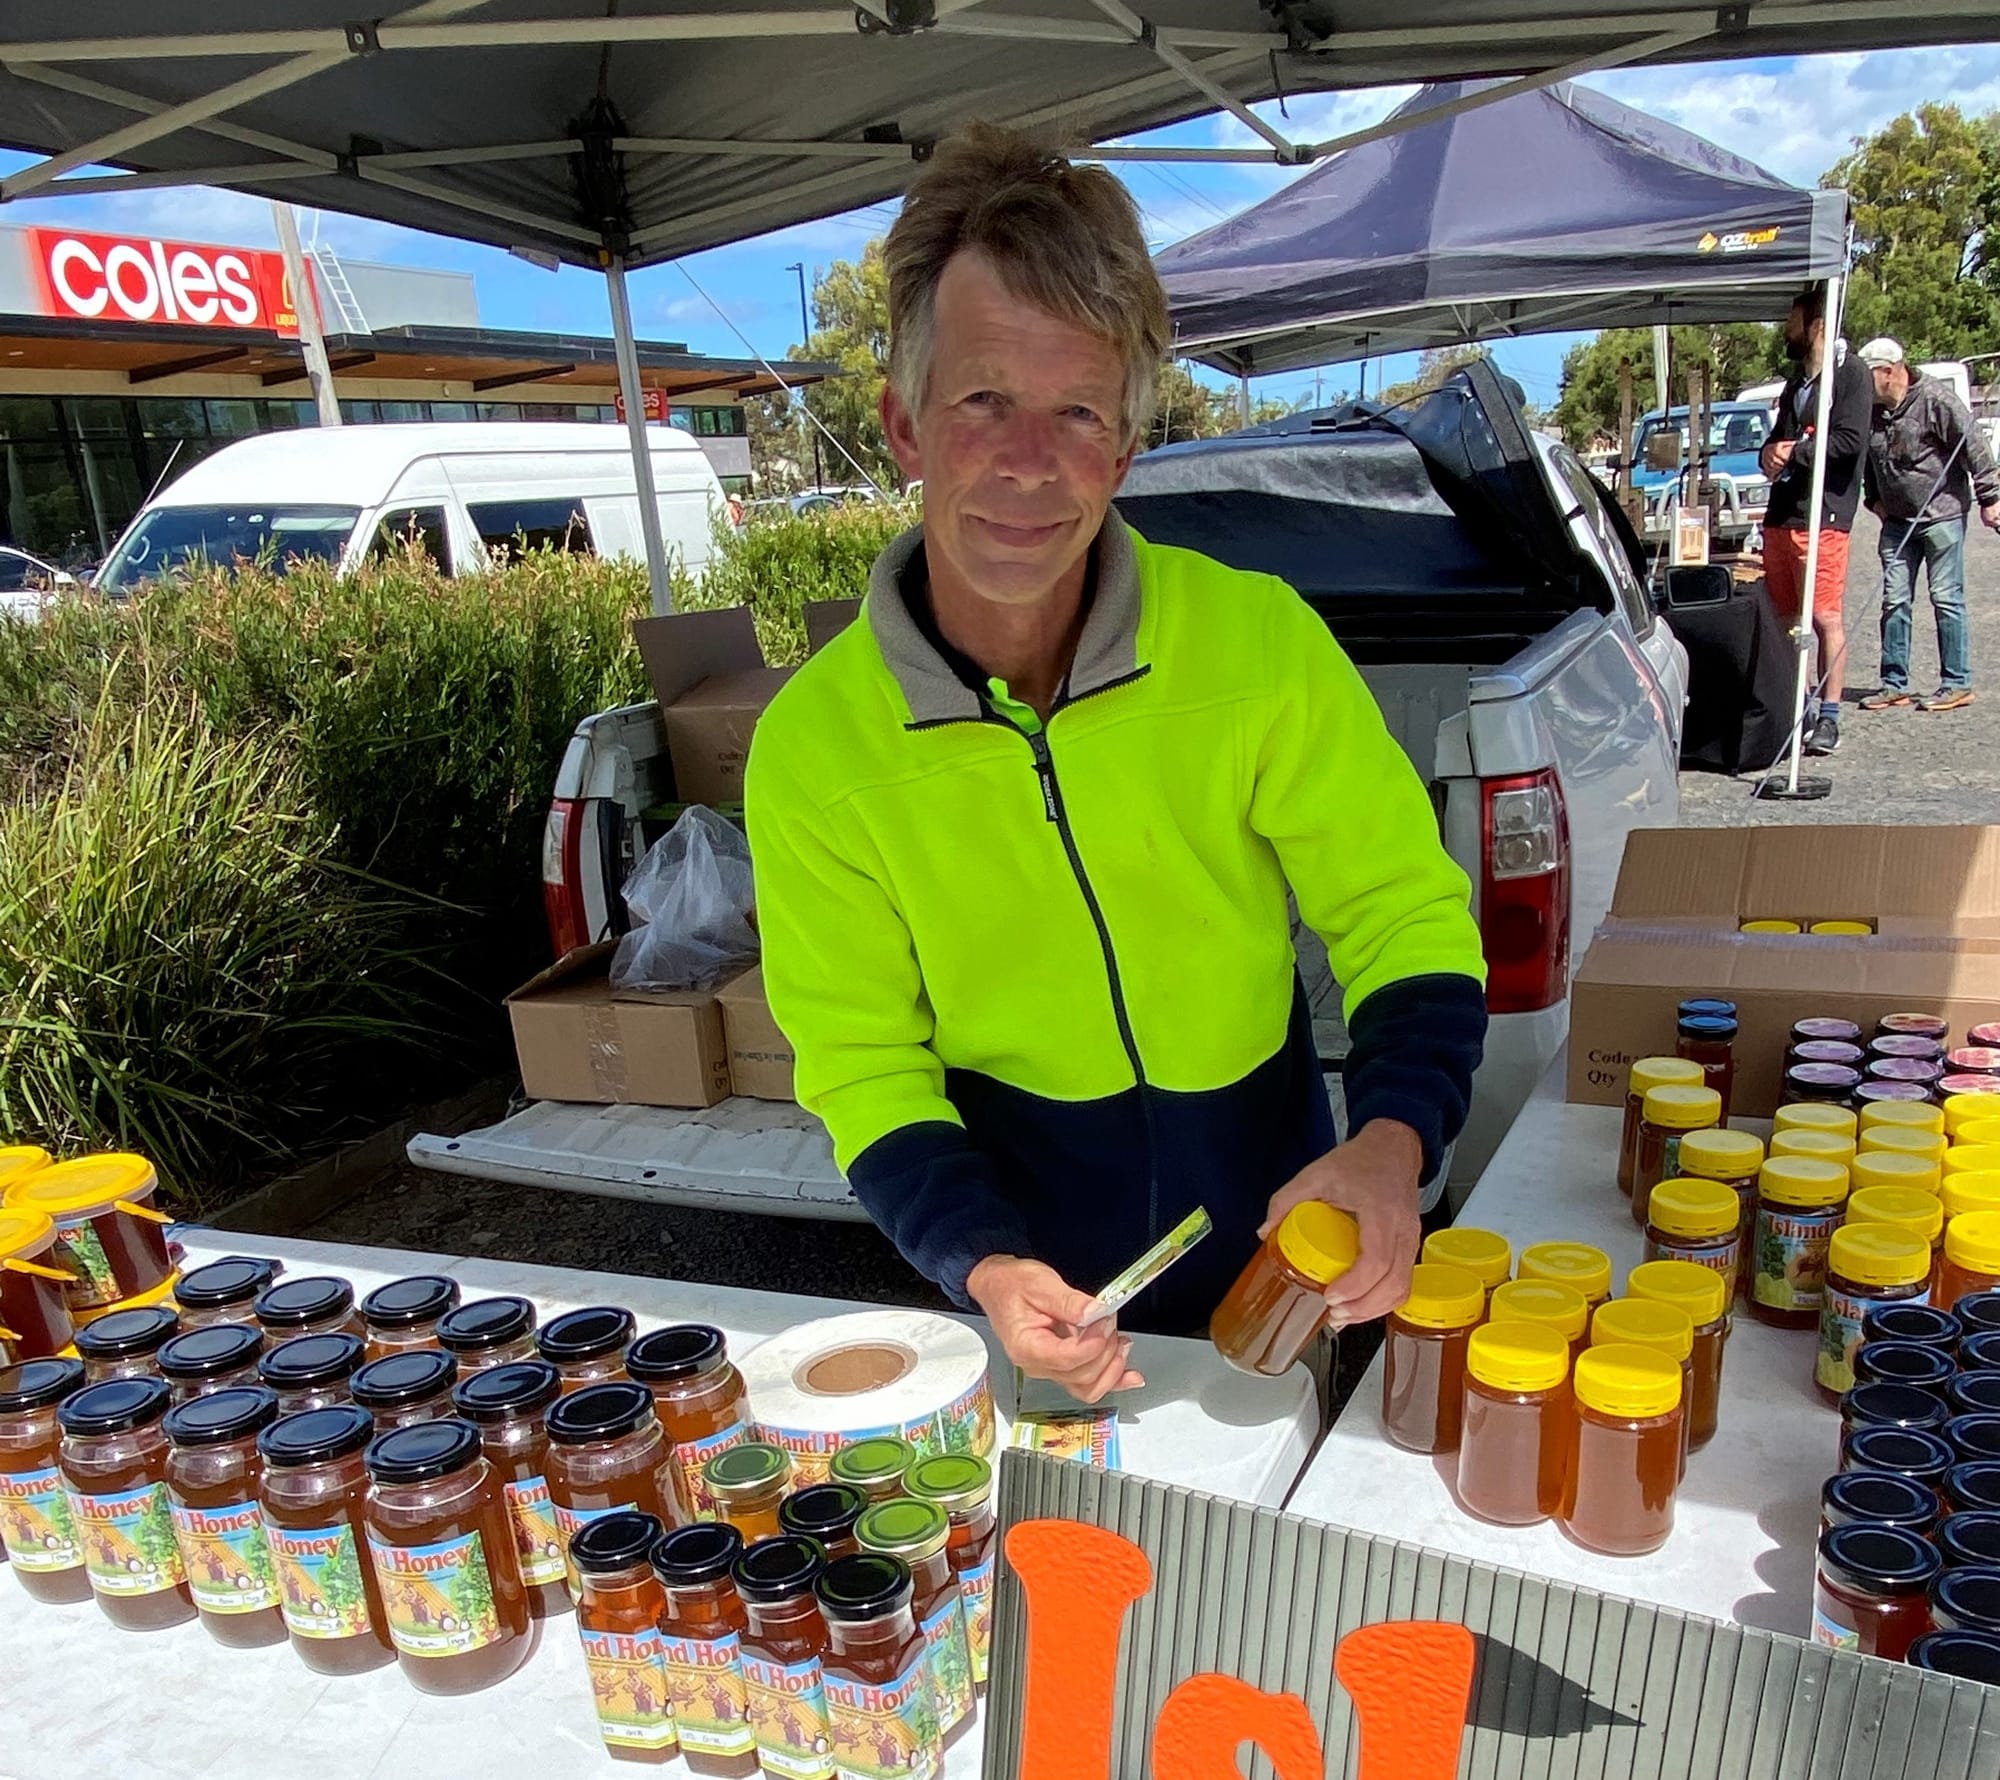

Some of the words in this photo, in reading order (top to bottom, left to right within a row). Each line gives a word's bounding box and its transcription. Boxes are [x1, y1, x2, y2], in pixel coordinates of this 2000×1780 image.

[51, 238, 257, 326] coles
[1587, 1070, 1616, 1088] Qty
[1766, 1214, 1832, 1239] Island
[761, 1425, 817, 1452] Island
[1090, 1429, 1112, 1468] Hone
[79, 1494, 155, 1519] Honey
[187, 1509, 262, 1535] Honey
[269, 1530, 343, 1558] Honey
[391, 1545, 471, 1573] Honey
